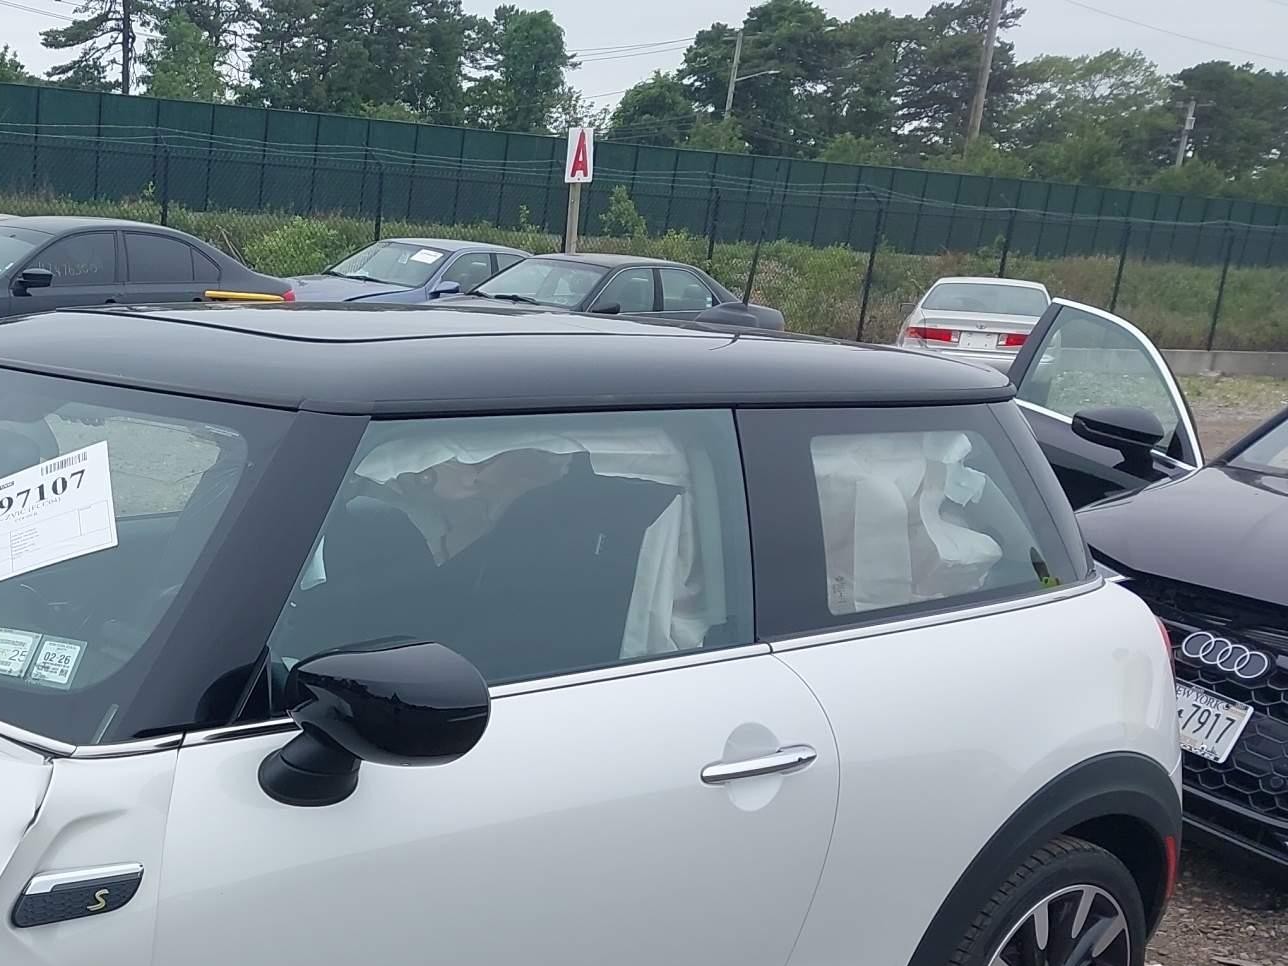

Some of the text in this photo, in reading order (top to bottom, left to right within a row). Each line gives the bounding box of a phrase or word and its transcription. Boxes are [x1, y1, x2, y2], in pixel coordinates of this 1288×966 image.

[570, 129, 589, 178] A
[1193, 689, 1224, 711] YORK
[86, 888, 110, 911] S
